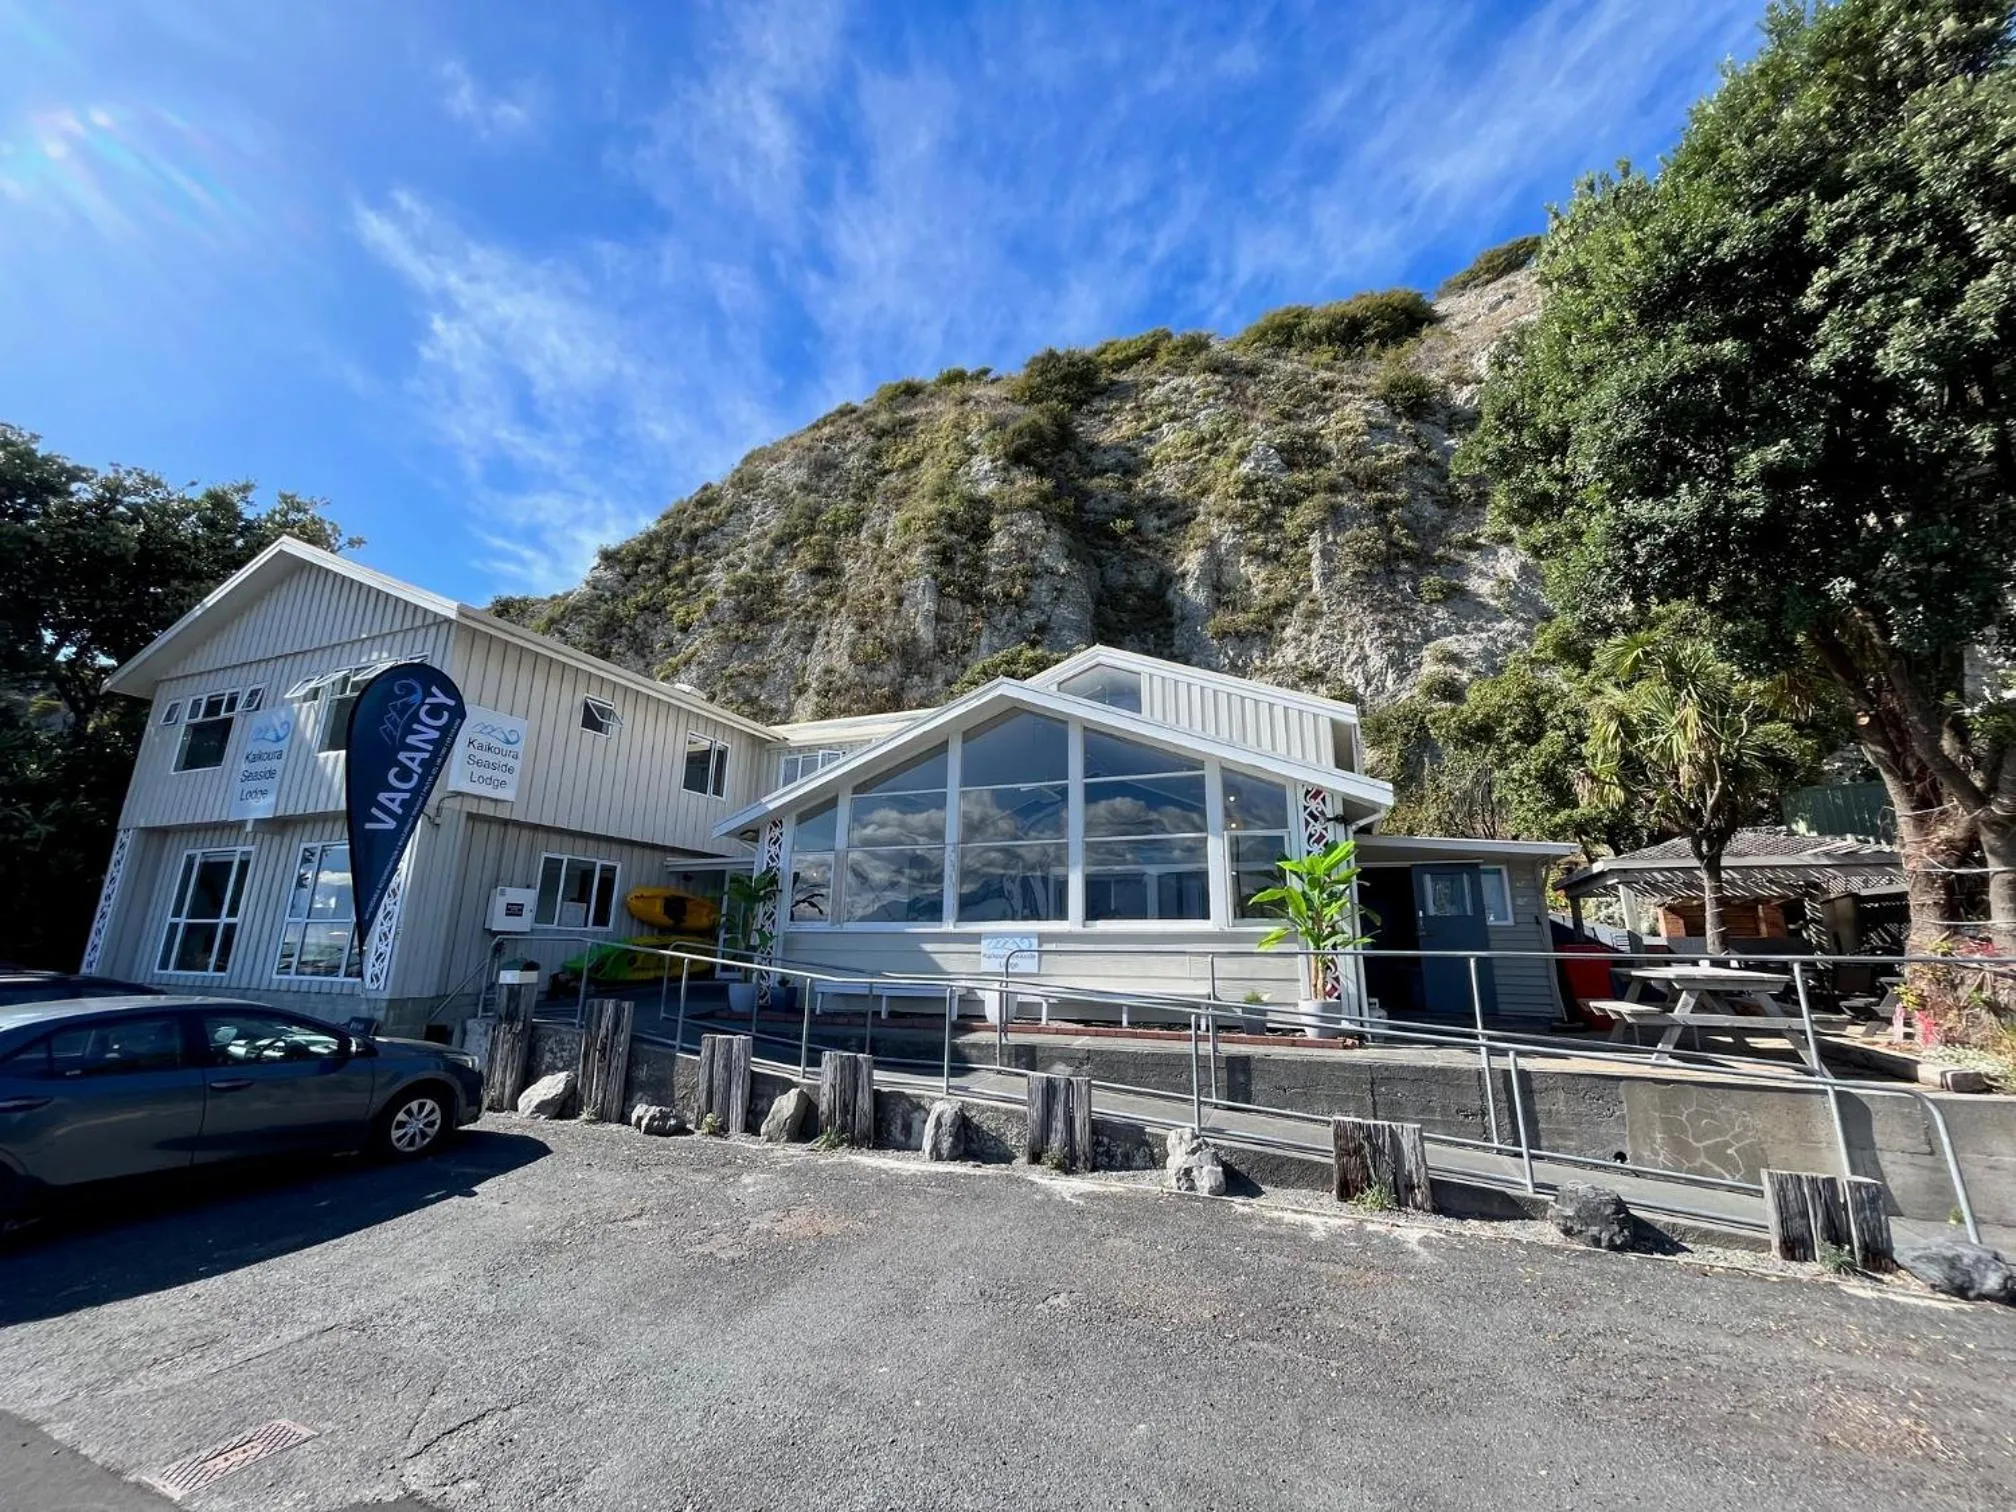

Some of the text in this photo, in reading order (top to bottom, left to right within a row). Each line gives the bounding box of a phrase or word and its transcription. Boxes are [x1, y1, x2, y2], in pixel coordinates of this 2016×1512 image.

[244, 749, 283, 764] Kaikoura
[364, 685, 456, 830] VACANCY
[467, 737, 519, 760] Kaikoura
[467, 753, 515, 775] Seaside
[240, 767, 278, 782] Seaside
[469, 771, 508, 790] Lodge
